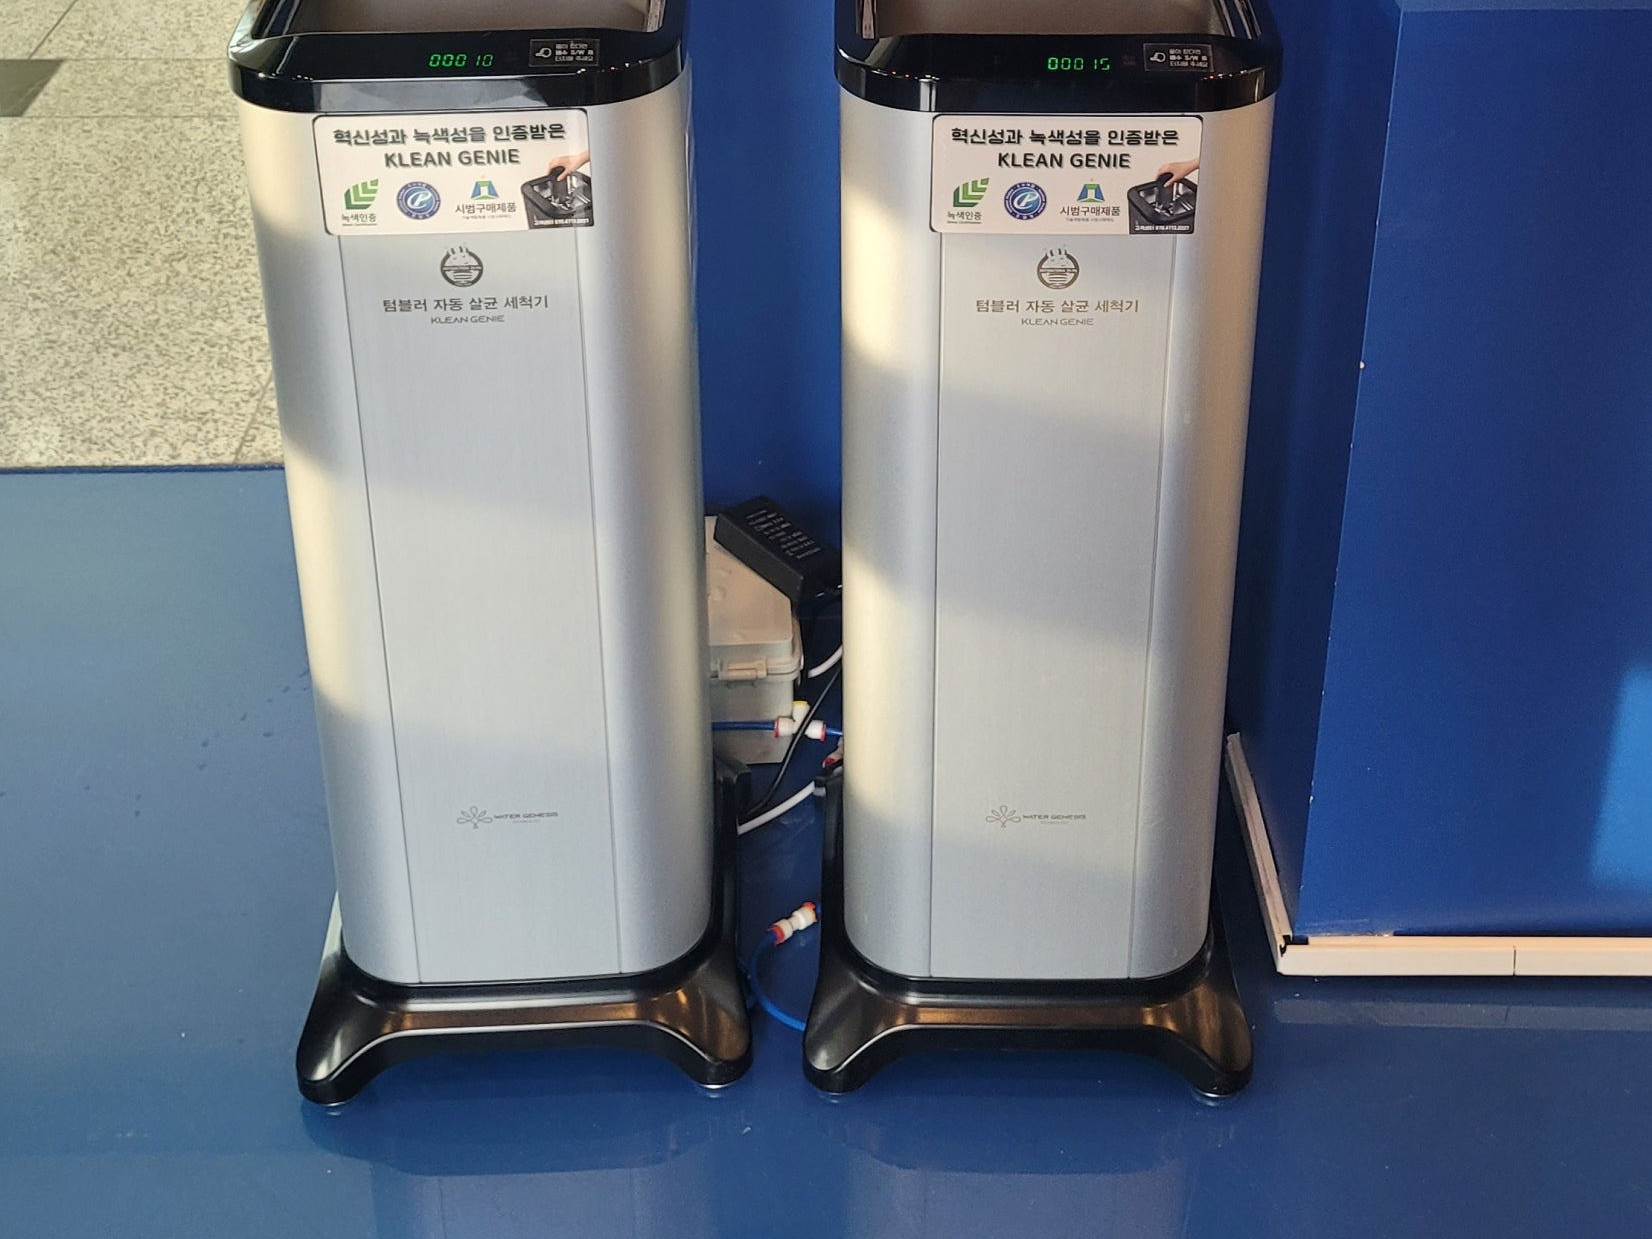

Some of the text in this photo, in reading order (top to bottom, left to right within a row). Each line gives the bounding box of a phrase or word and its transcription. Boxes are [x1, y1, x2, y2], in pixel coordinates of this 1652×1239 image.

[333, 123, 566, 146] 혁신성과 녹색성을 인증받은
[951, 127, 1179, 146] 혁신성과 녹색성을 인증받은
[384, 148, 520, 168] KLEAN GENIE
[998, 152, 1131, 169] KLEAN GENIE
[455, 202, 517, 214] 시범구매제품
[1059, 206, 1120, 216] 시범구매제품
[341, 213, 377, 222] 녹색인증
[947, 211, 981, 220] 녹색인증
[383, 295, 548, 312] 텀블러 자동 살균 세척기
[976, 299, 1139, 313] 텀블러 자동 살균 세척기
[431, 315, 505, 324] KLEAN GENIE
[1021, 318, 1094, 326] KLEAN GENIE
